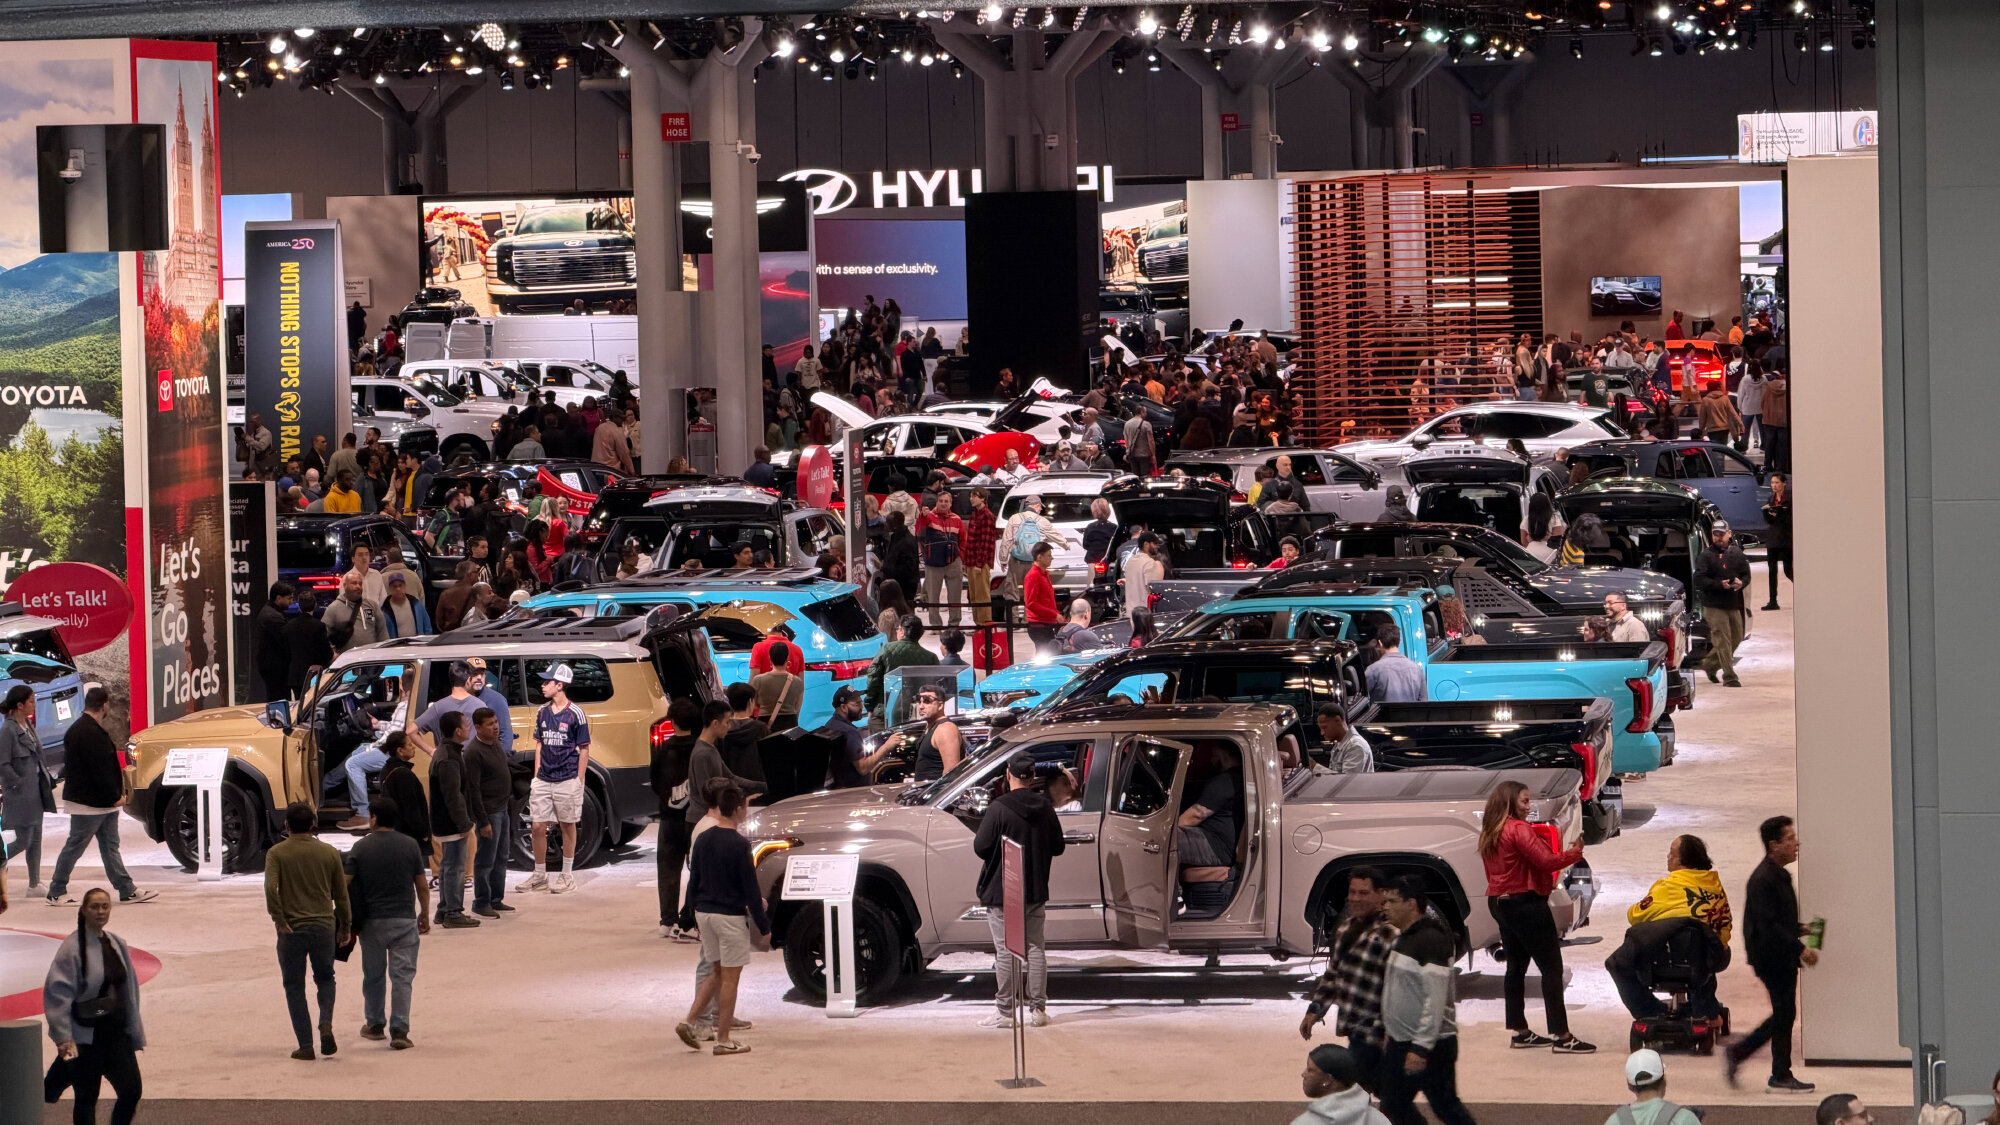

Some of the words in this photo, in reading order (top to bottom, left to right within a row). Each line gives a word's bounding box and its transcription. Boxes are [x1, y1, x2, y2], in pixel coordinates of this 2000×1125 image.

[668, 117, 685, 126] FIRE
[666, 129, 688, 137] HOSE
[291, 237, 315, 250] 250
[816, 263, 832, 275] ith
[834, 266, 841, 275] a
[843, 266, 872, 275] sense
[874, 263, 885, 274] of
[886, 262, 938, 276] exclusivity.
[280, 261, 300, 332] NOTHING
[280, 335, 300, 389] STOPS
[0, 385, 88, 406] OYOTA
[175, 375, 210, 398] TOYOTA
[280, 425, 301, 463] RAM
[230, 539, 250, 552] ur
[159, 536, 201, 586] Let's
[231, 560, 250, 574] ta
[22, 591, 62, 608] Let's
[65, 590, 107, 607] Talk!
[232, 602, 251, 616] ts
[42, 613, 89, 629] ally)
[160, 602, 189, 647] Go
[163, 659, 220, 708] Places
